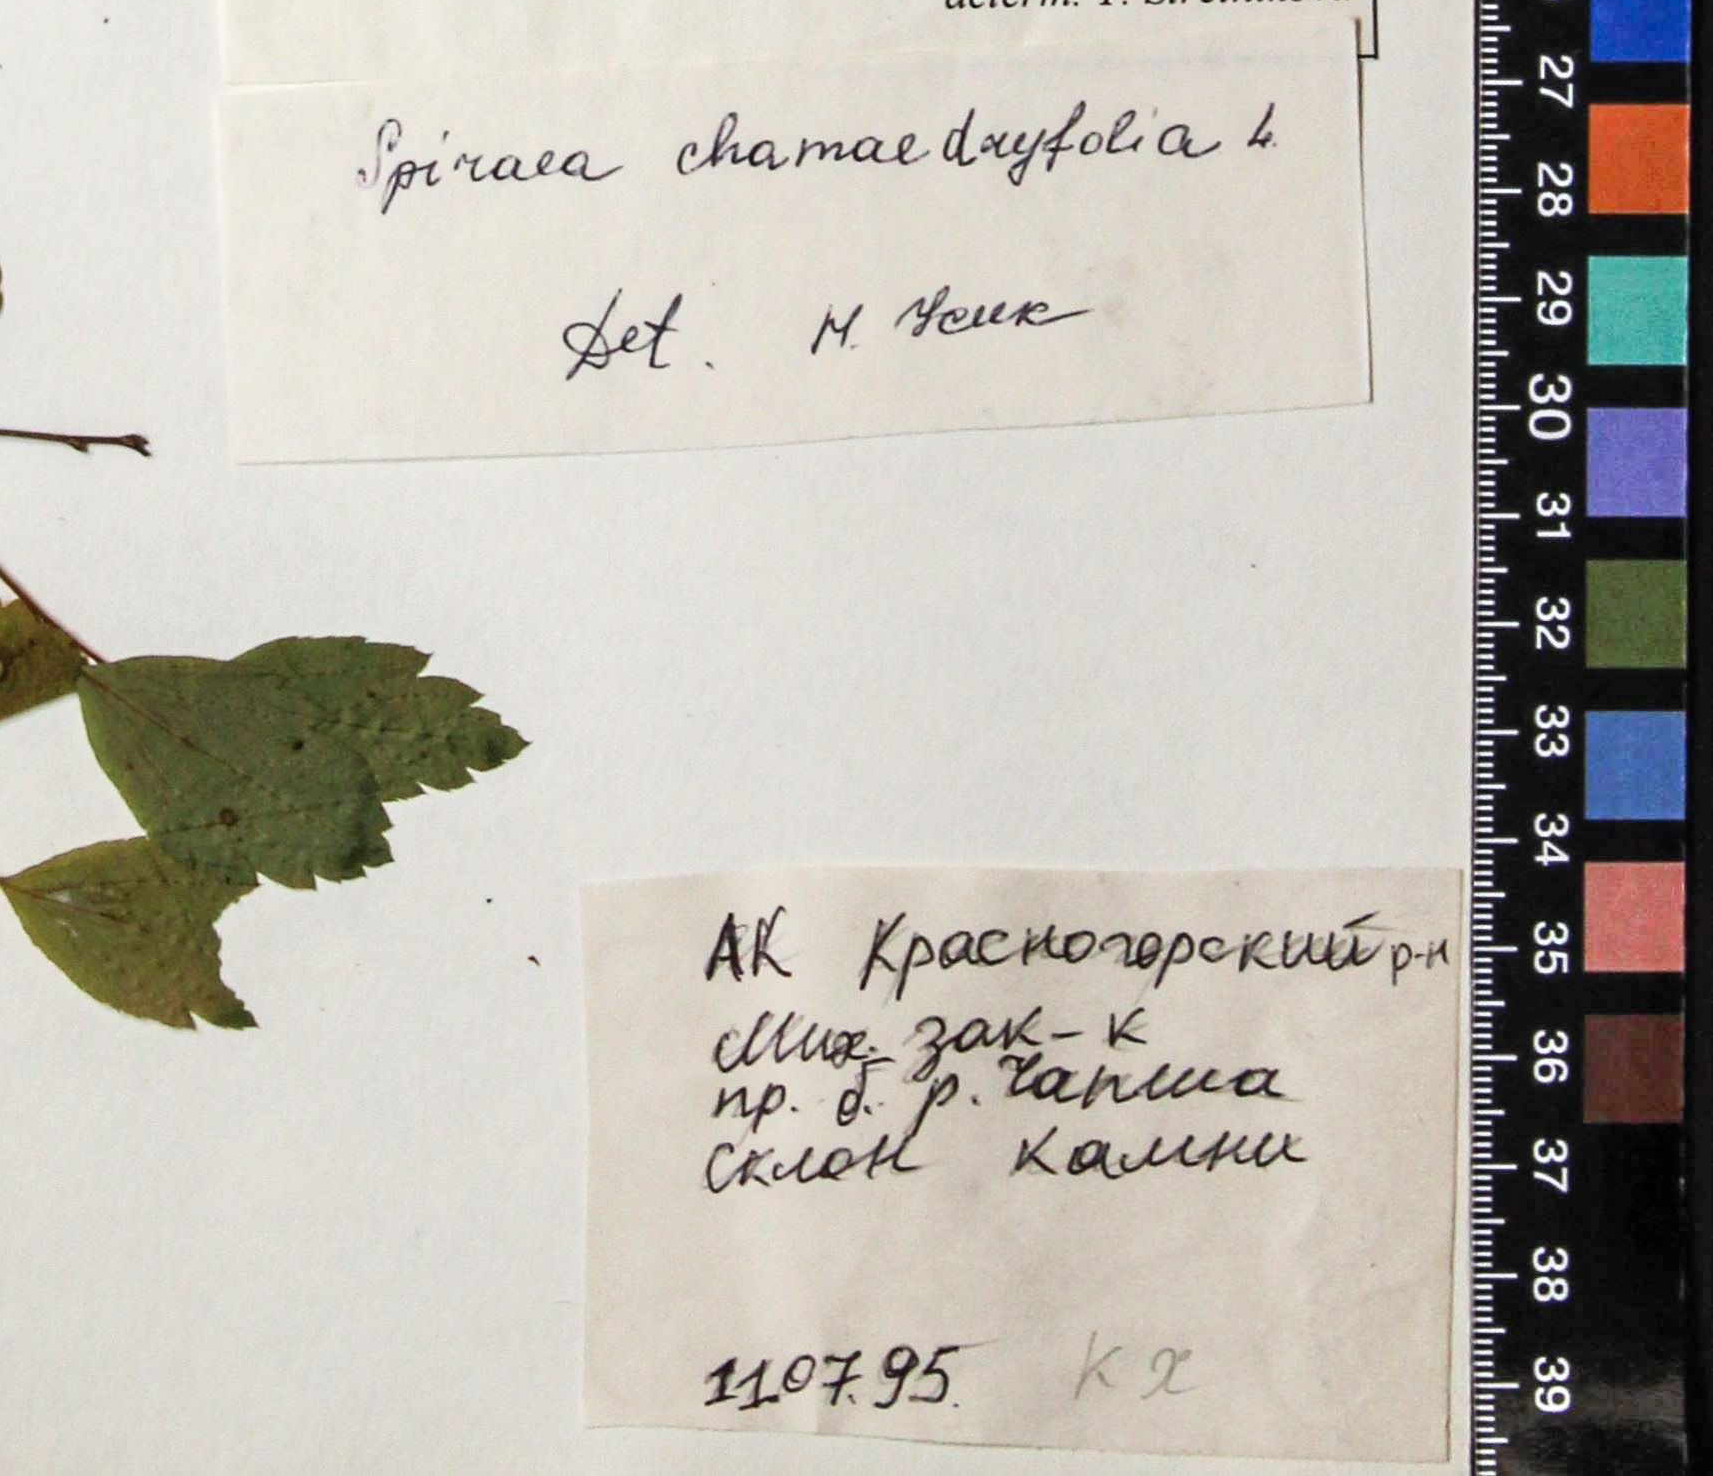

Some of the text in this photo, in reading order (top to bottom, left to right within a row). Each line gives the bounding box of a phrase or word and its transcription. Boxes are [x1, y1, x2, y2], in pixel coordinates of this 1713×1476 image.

[1538, 54, 1575, 109] 27
[1536, 161, 1574, 218] 28
[1536, 269, 1574, 327] 29
[1527, 372, 1573, 441] 30
[1535, 491, 1573, 539] 31
[1534, 596, 1572, 650] 32
[1533, 704, 1571, 758] 33
[1532, 812, 1571, 867] 34
[704, 905, 793, 983] АК
[1532, 920, 1570, 976] 35
[1532, 1028, 1570, 1085] 36
[1532, 1137, 1570, 1194] 37
[1531, 1245, 1570, 1303] 38
[1532, 1355, 1572, 1414] 39
